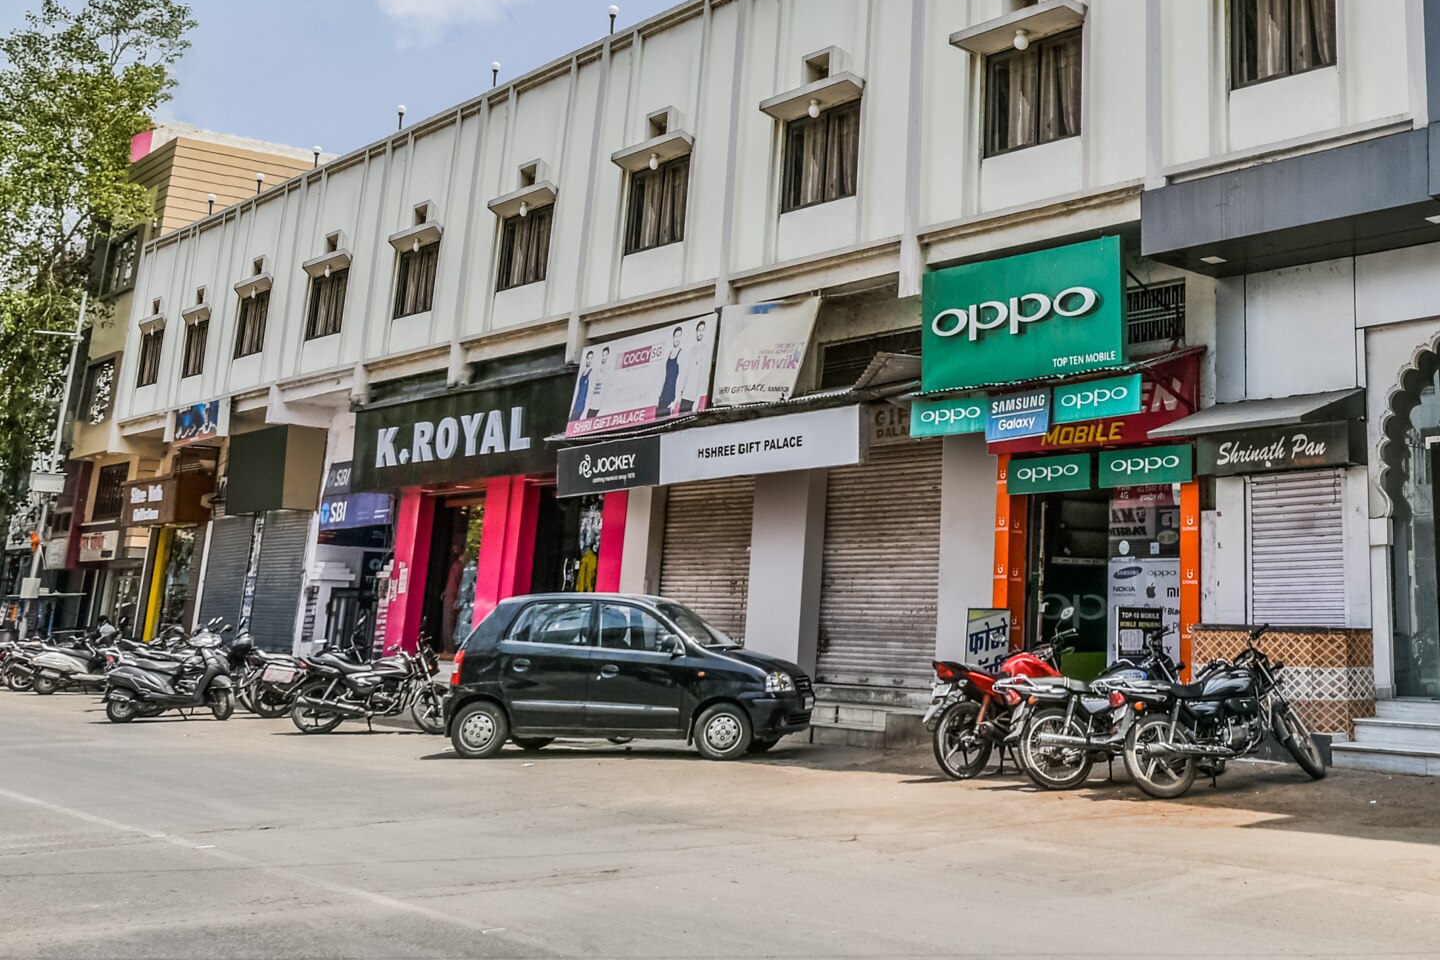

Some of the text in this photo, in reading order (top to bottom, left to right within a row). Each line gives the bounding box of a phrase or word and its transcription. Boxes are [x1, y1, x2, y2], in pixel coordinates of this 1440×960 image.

[931, 286, 1098, 341] oppo
[1052, 351, 1116, 367] TOP TEN MOBILE
[991, 394, 1046, 414] SAMSUNG
[1061, 386, 1128, 409] oppo
[573, 410, 646, 433] SHRI GIFT PALACE
[875, 407, 909, 427] GIF
[920, 406, 981, 425] oppo
[998, 416, 1035, 431] Galaxy
[375, 406, 531, 468] K.ROYAL
[1041, 422, 1125, 446] MOBILE
[738, 441, 761, 455] GIFT
[764, 436, 802, 451] PALACE
[1217, 433, 1326, 466] Shrinath Pan
[592, 454, 636, 473] JOCKEY
[1017, 464, 1079, 482] oppo
[1110, 455, 1180, 475] oppo
[334, 468, 352, 487] SBI
[329, 501, 348, 523] SBI
